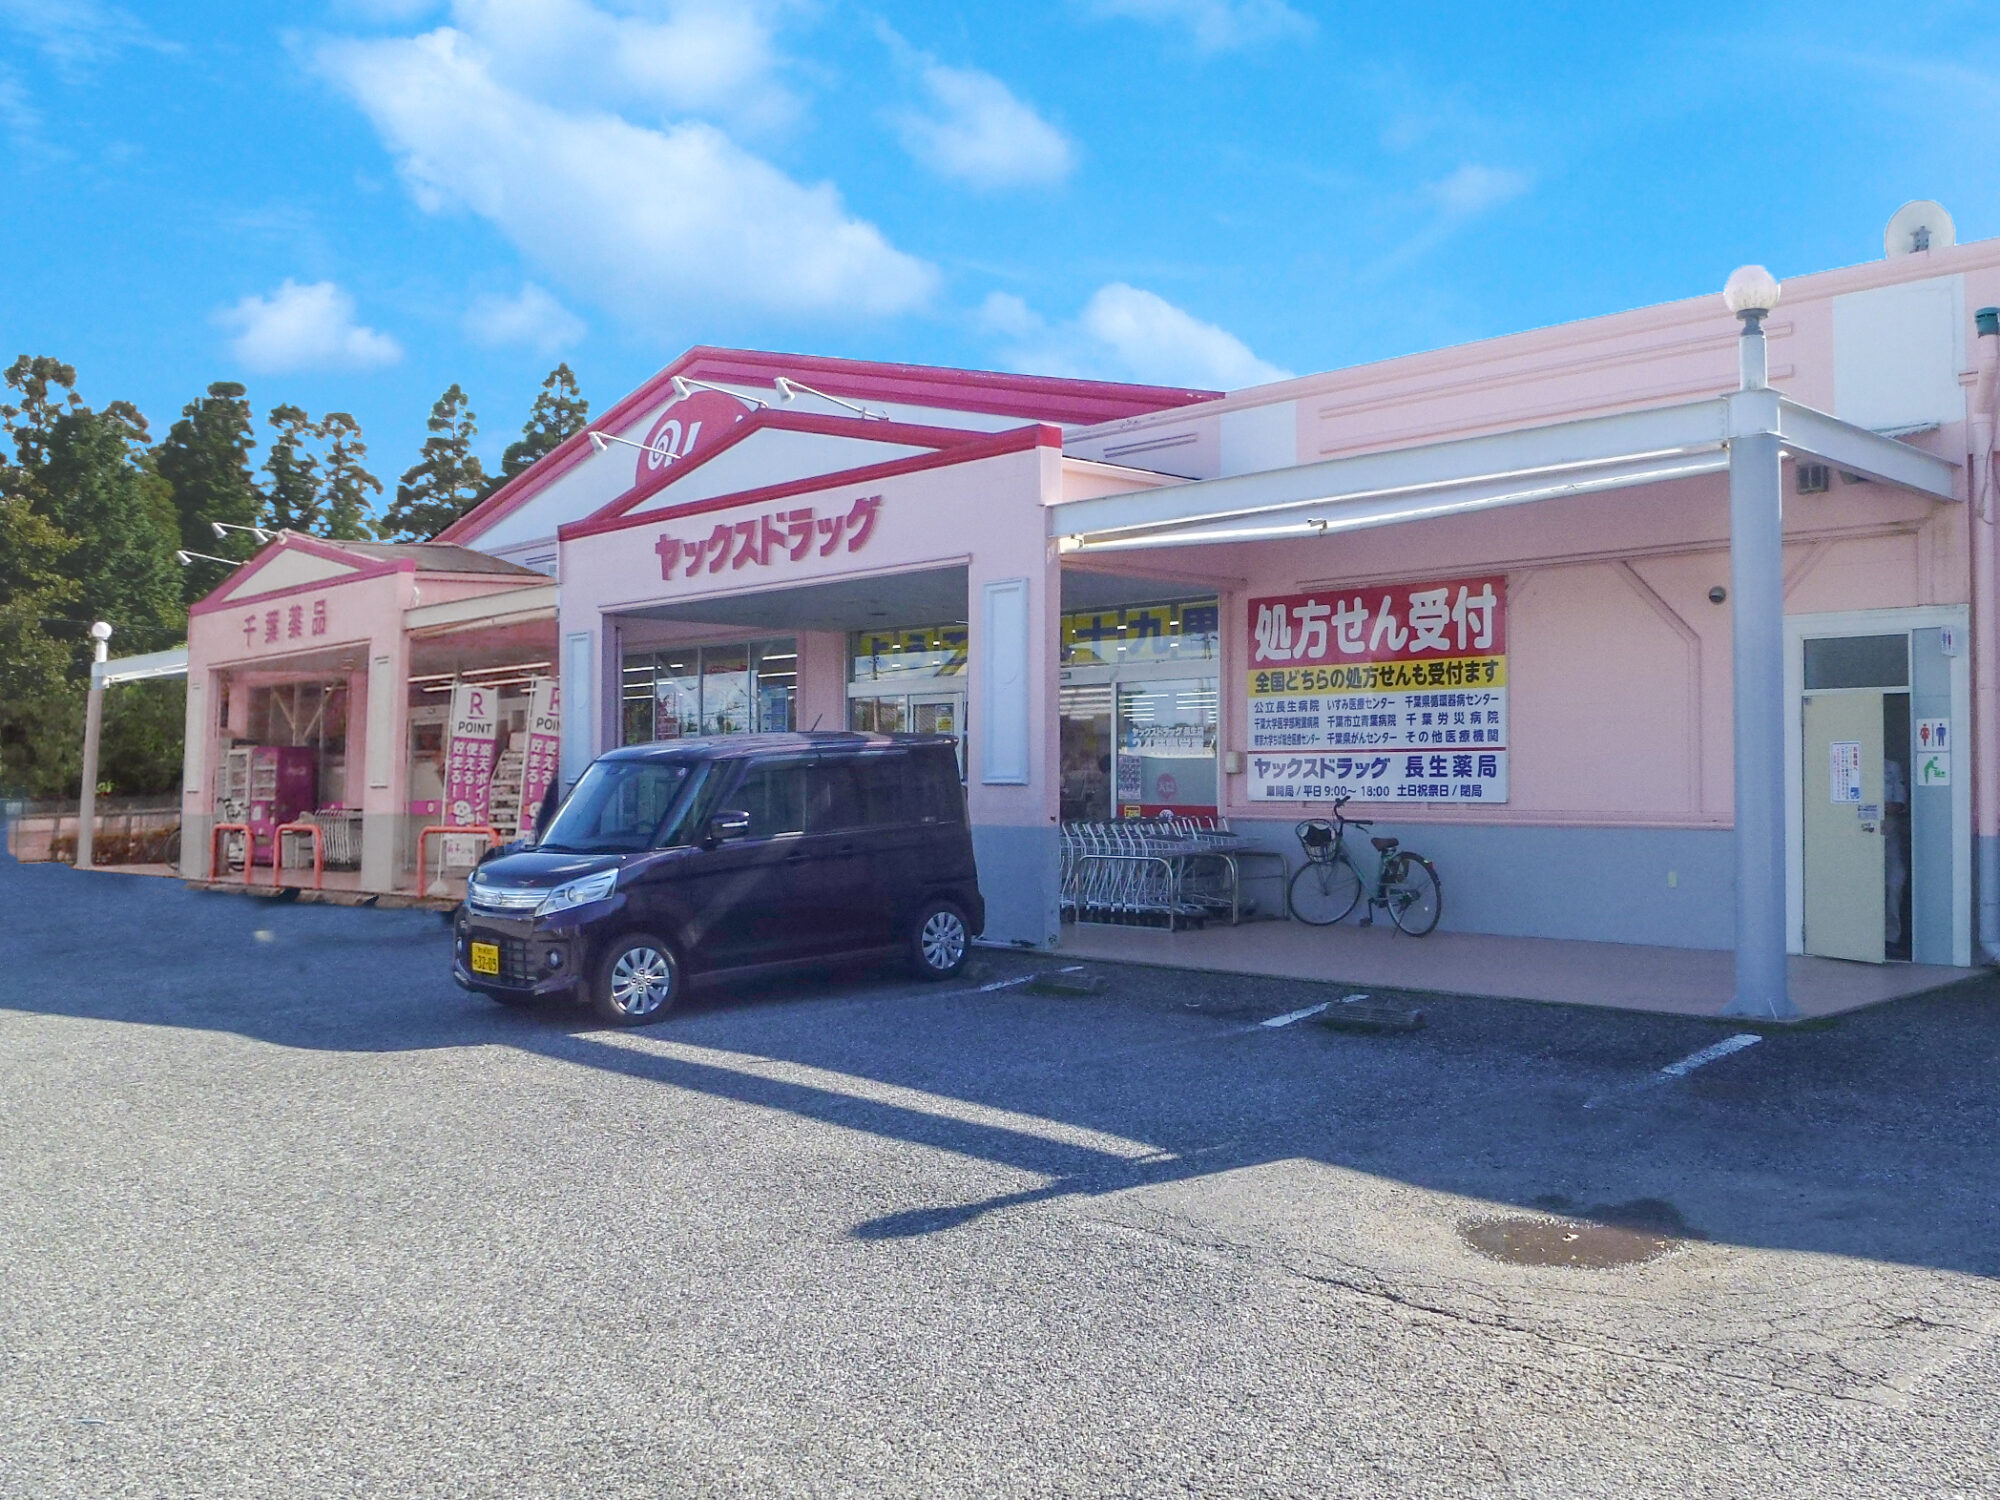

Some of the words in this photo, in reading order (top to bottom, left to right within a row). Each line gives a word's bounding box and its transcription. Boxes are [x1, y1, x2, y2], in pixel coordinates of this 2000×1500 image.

[655, 495, 882, 580] ヤックスドラッグ
[243, 599, 326, 647] 千葉薬品
[1254, 583, 1498, 662] 処方せん受付
[1255, 660, 1499, 694] 全国どちらの処方せんも受付ます
[1254, 700, 1320, 713] 公立長生病院
[1327, 697, 1395, 711] いすみ医療センター
[1405, 693, 1499, 708] 千葉県循環器病センター
[458, 720, 493, 735] POINT
[1327, 714, 1397, 728] 千葉市立青葉病院
[1406, 711, 1499, 726] 千葉労災病院
[1327, 731, 1397, 745] 千葉県がんセンター
[1405, 729, 1499, 743] その他医療機関
[1254, 757, 1391, 779] ヤックスドラッグ
[1405, 755, 1497, 778] 長生薬局
[475, 743, 492, 825] 楽天ポイント
